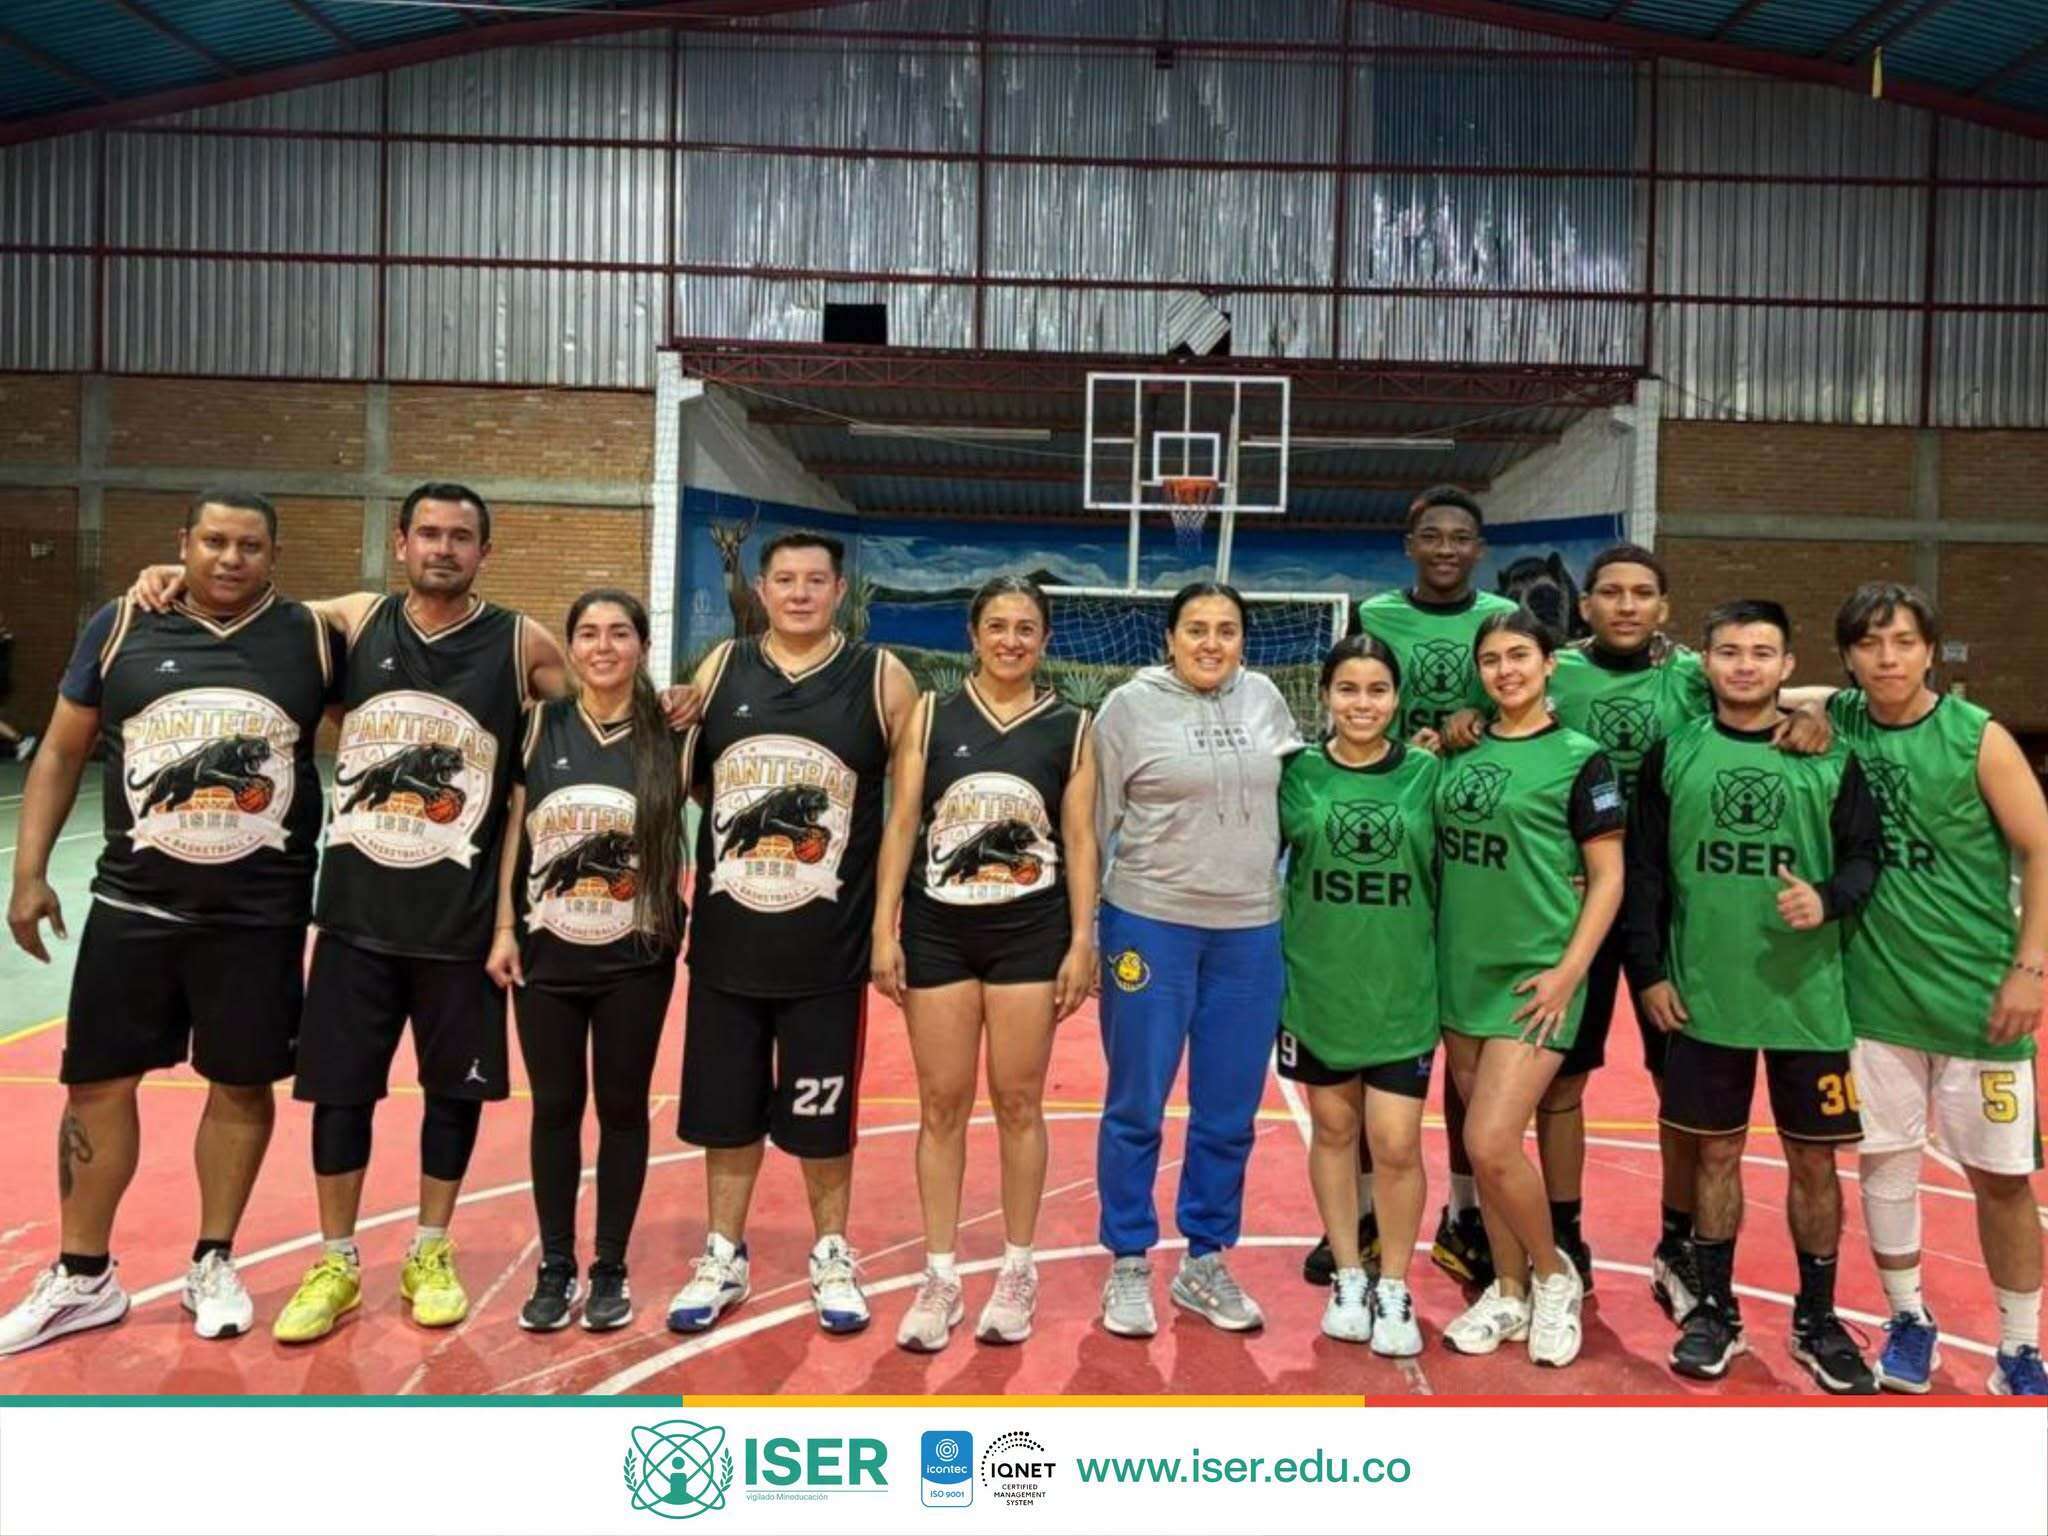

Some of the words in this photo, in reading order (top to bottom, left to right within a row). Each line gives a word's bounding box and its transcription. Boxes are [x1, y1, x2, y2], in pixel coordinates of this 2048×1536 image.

[1696, 840, 1797, 877] ISER
[1312, 869, 1412, 907] ISER
[792, 1075, 844, 1116] 27
[1980, 1071, 2018, 1123] 5
